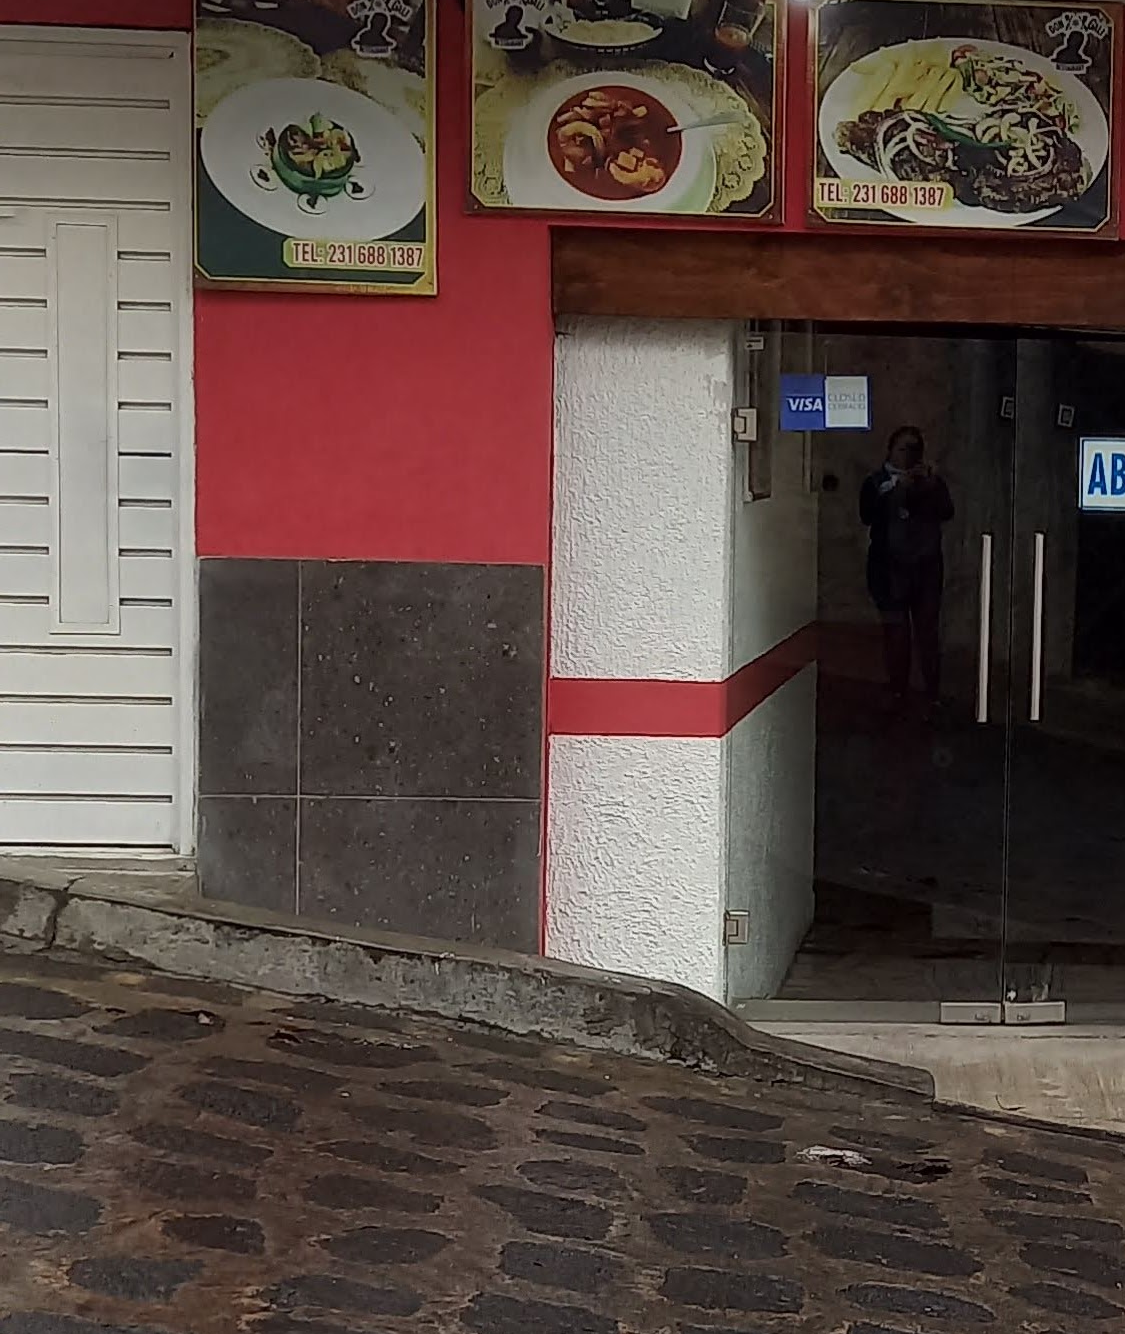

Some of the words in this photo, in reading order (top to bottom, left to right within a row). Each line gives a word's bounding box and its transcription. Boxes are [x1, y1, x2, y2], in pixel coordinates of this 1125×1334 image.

[819, 183, 848, 202] TEL:
[853, 185, 876, 203] 231
[881, 185, 907, 204] 688
[914, 187, 944, 206] 1387
[293, 242, 324, 263] TEL:
[328, 244, 352, 263] 231
[357, 245, 385, 265] 688
[390, 247, 423, 266] 1387
[786, 398, 823, 411] VISA
